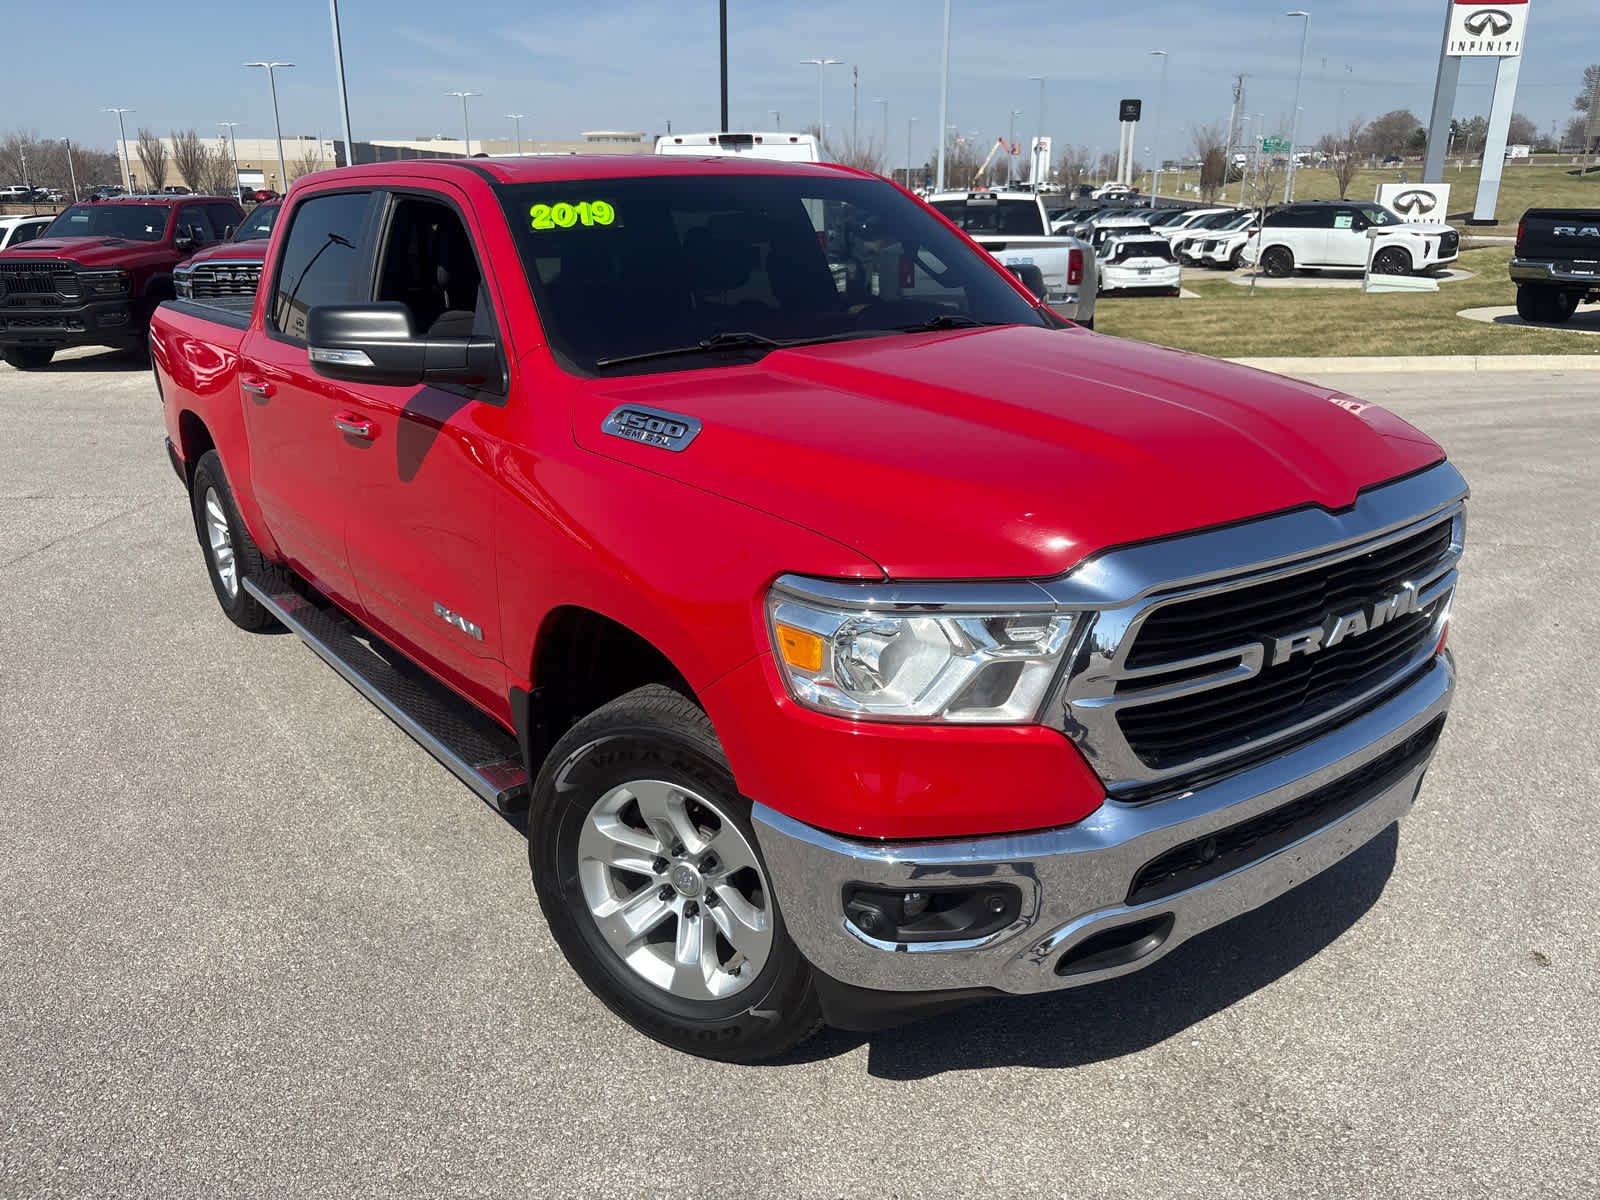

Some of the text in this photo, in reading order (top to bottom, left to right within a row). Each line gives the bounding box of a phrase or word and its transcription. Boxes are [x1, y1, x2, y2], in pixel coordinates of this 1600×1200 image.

[1450, 41, 1519, 51] INFINITI
[529, 200, 615, 229] 2019
[1553, 226, 1600, 237] RA
[613, 410, 687, 438] 1500
[618, 425, 647, 441] HEMI
[1271, 587, 1414, 667] RAM
